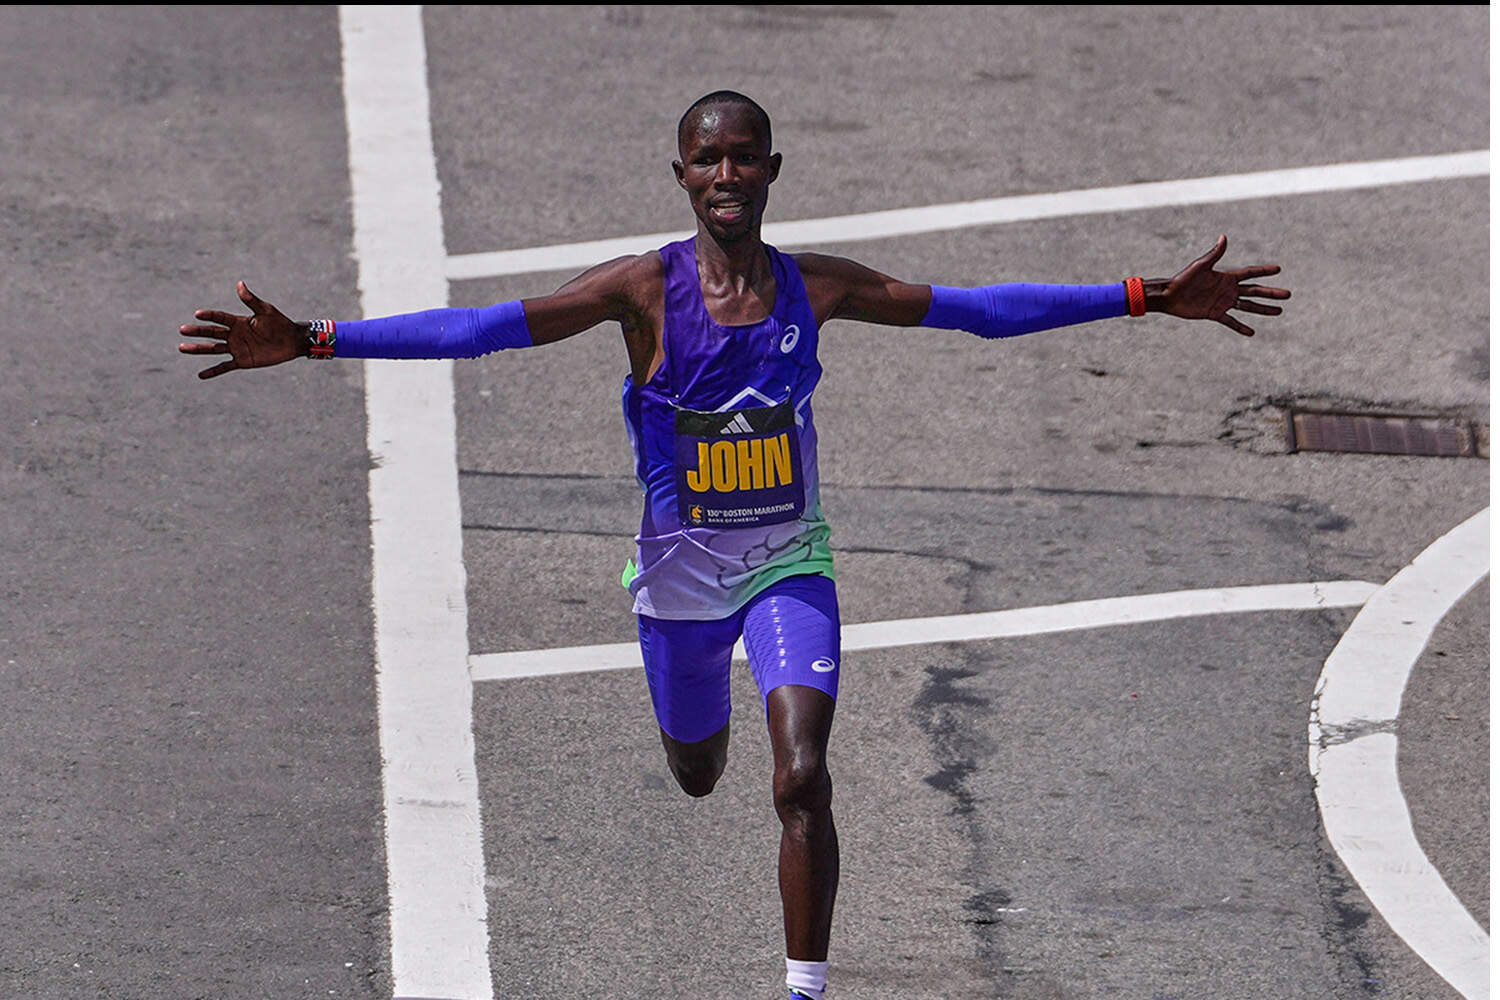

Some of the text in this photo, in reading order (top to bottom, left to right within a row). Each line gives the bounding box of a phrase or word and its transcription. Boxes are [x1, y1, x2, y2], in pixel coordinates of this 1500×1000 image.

[686, 433, 793, 493] JOHN
[723, 507, 753, 518] BOSTON
[754, 502, 795, 516] MARATHON
